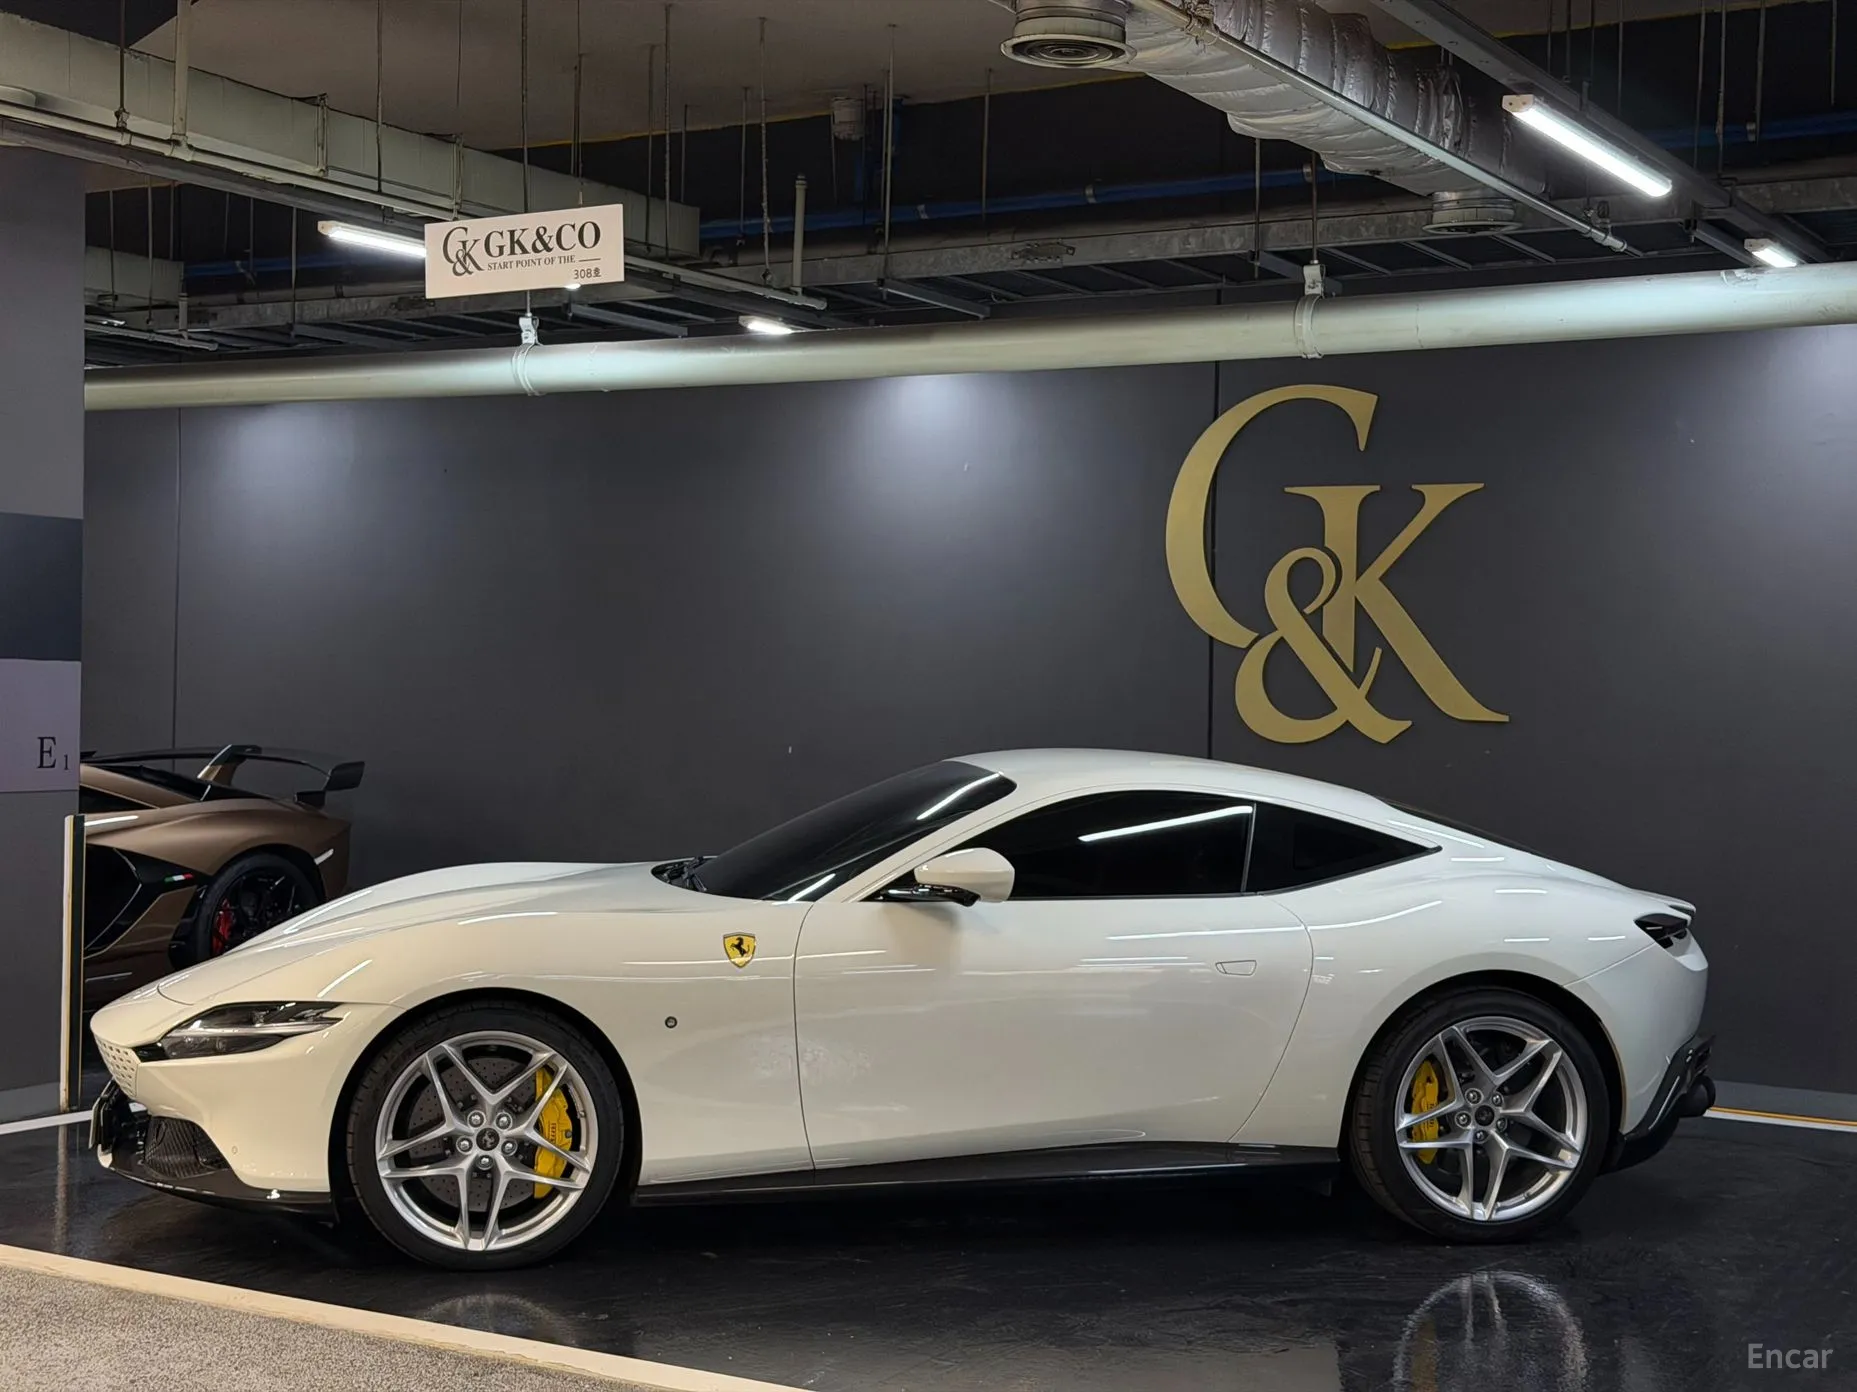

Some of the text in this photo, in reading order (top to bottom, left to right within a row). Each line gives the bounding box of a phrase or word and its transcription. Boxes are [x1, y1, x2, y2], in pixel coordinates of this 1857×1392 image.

[484, 221, 601, 258] GK&CO
[487, 255, 576, 271] START POINT OF THE
[573, 267, 602, 279] 308호
